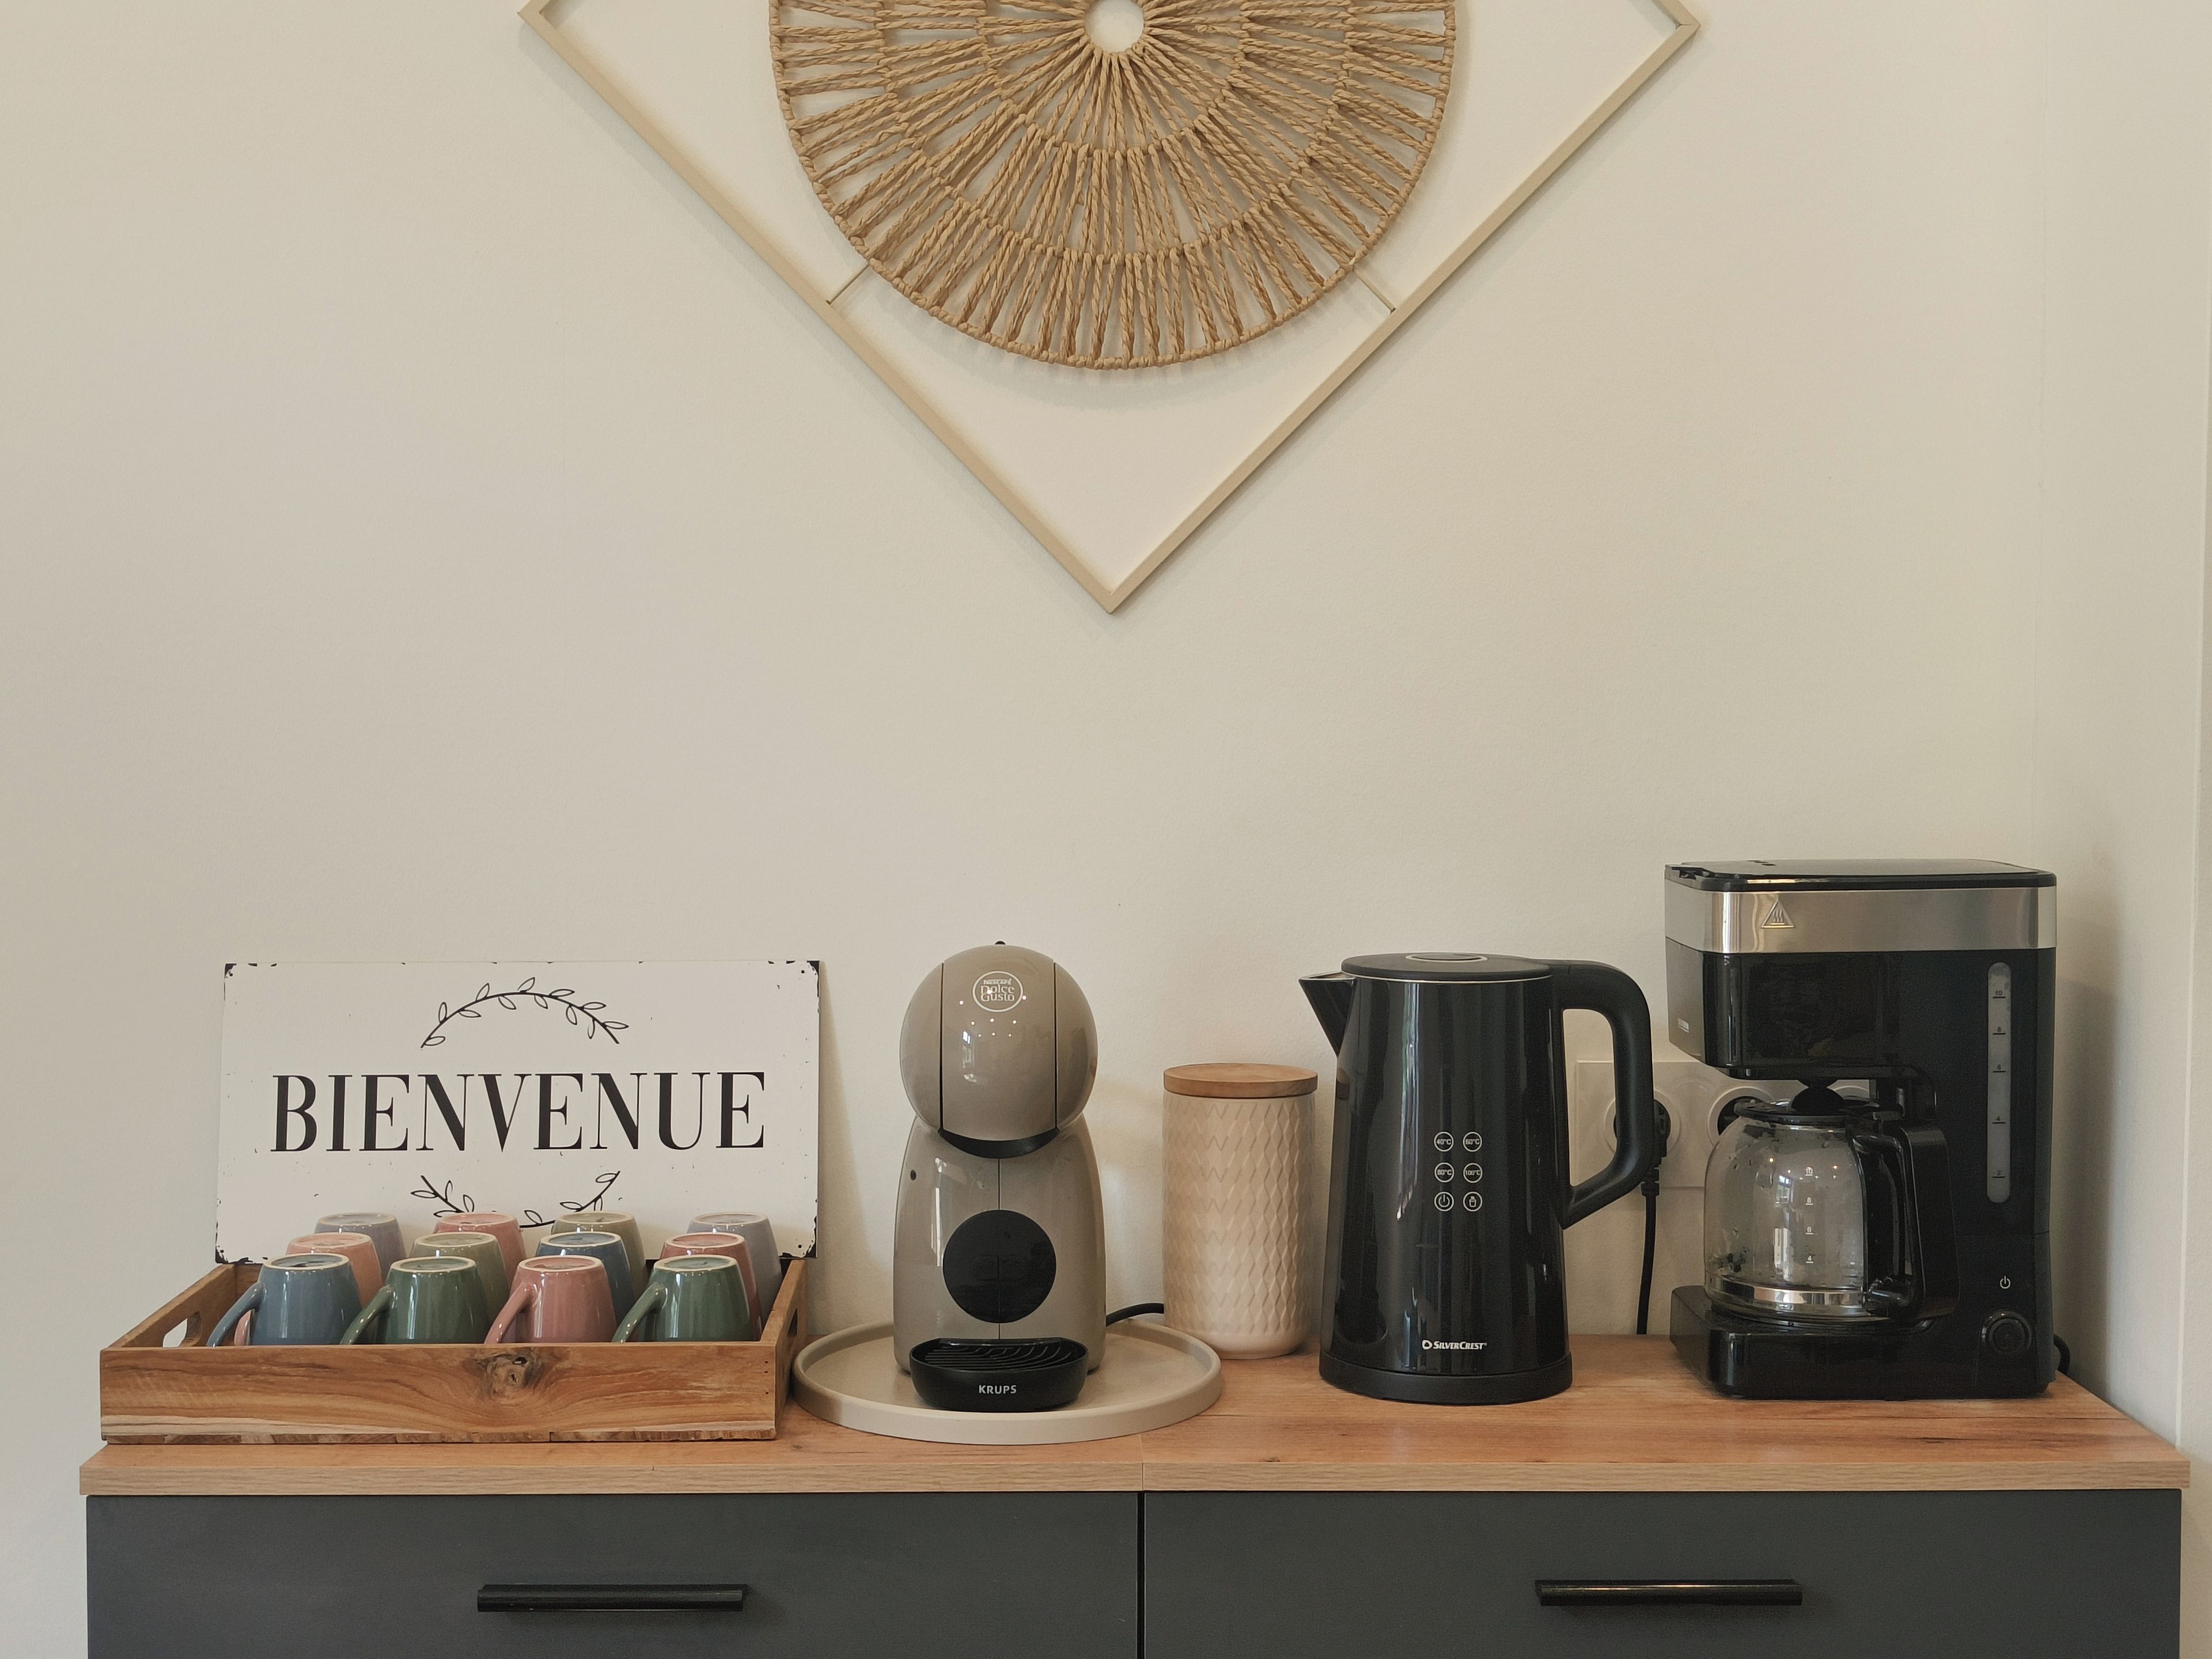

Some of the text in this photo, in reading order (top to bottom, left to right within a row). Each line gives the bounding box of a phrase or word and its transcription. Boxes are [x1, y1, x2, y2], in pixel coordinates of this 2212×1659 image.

[980, 984, 1015, 994] Dolce
[980, 993, 1015, 1002] Gusto
[270, 1071, 766, 1153] BIENVENUE
[979, 1385, 1017, 1394] KRUPS
